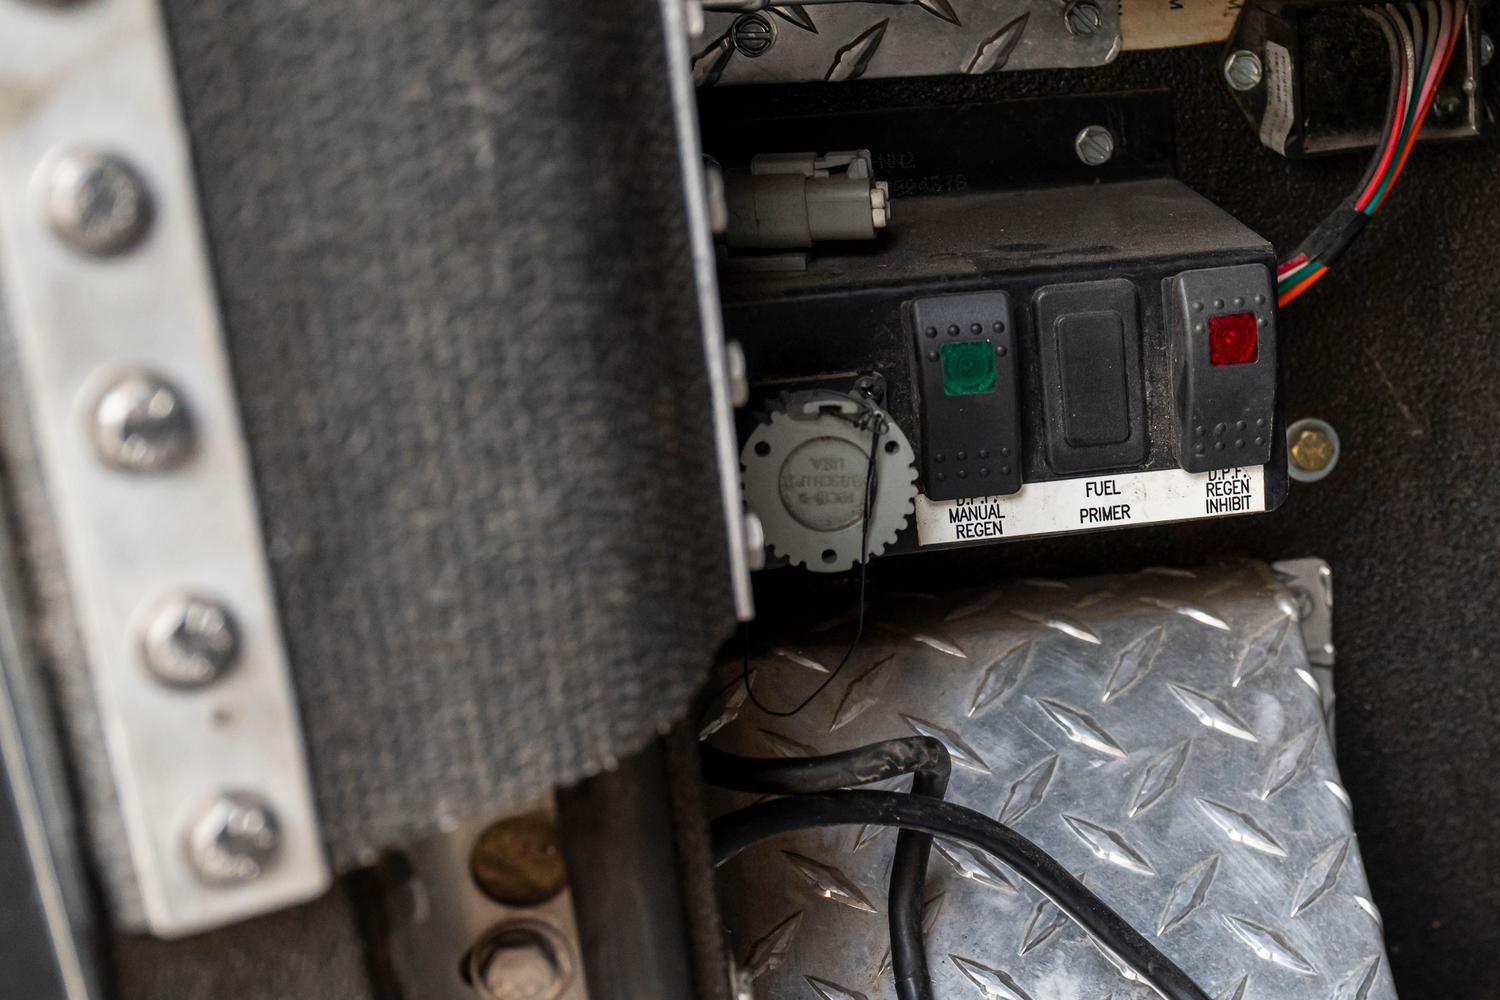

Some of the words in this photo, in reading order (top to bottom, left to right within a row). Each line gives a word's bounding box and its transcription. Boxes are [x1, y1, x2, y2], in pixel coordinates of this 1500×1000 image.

[1086, 480, 1121, 498] FUEL
[1206, 479, 1250, 498] REGEN
[949, 503, 1006, 524] MANUAL
[1080, 504, 1131, 524] PRIMER
[1206, 495, 1252, 514] INHIBIT
[955, 520, 1003, 539] REGEN
